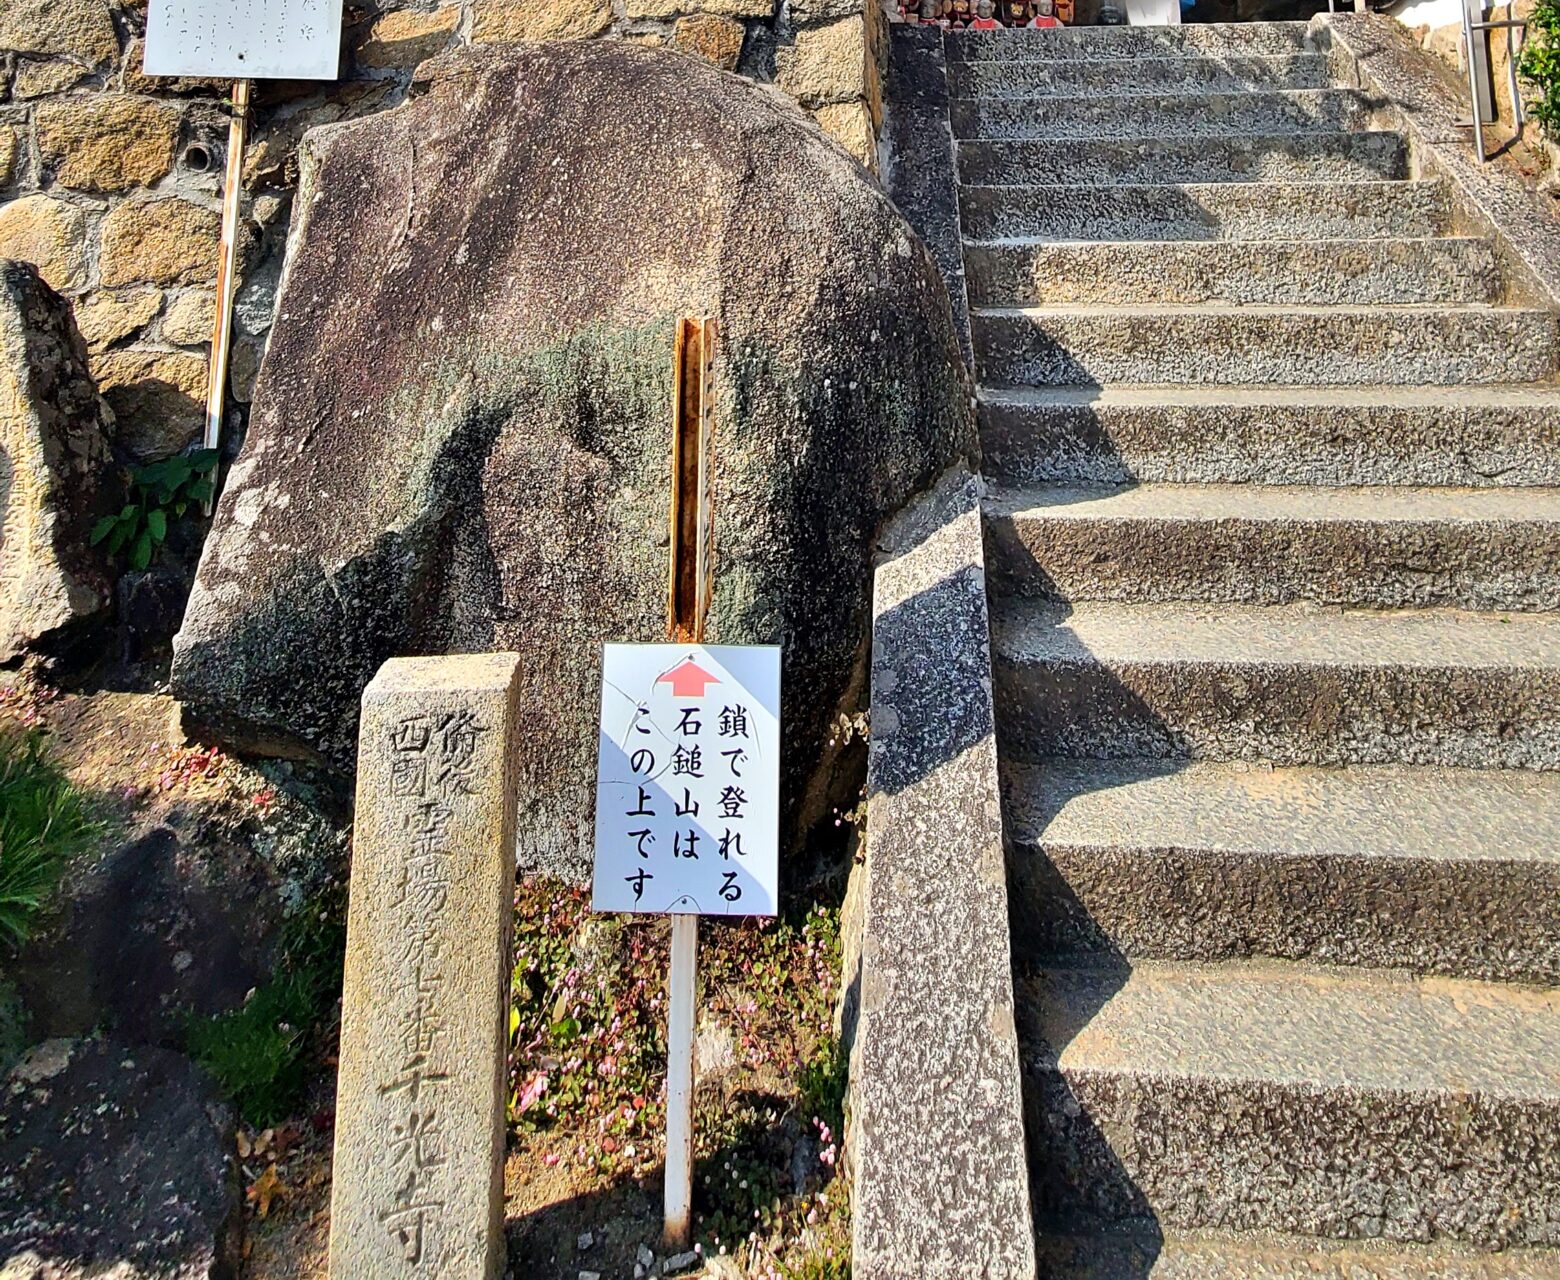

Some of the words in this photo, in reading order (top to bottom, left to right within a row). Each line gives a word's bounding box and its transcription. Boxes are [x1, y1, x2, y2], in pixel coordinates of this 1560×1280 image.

[625, 705, 657, 902] この上です
[672, 706, 705, 860] 石鎚山は
[717, 703, 749, 902] 鎖で登れる
